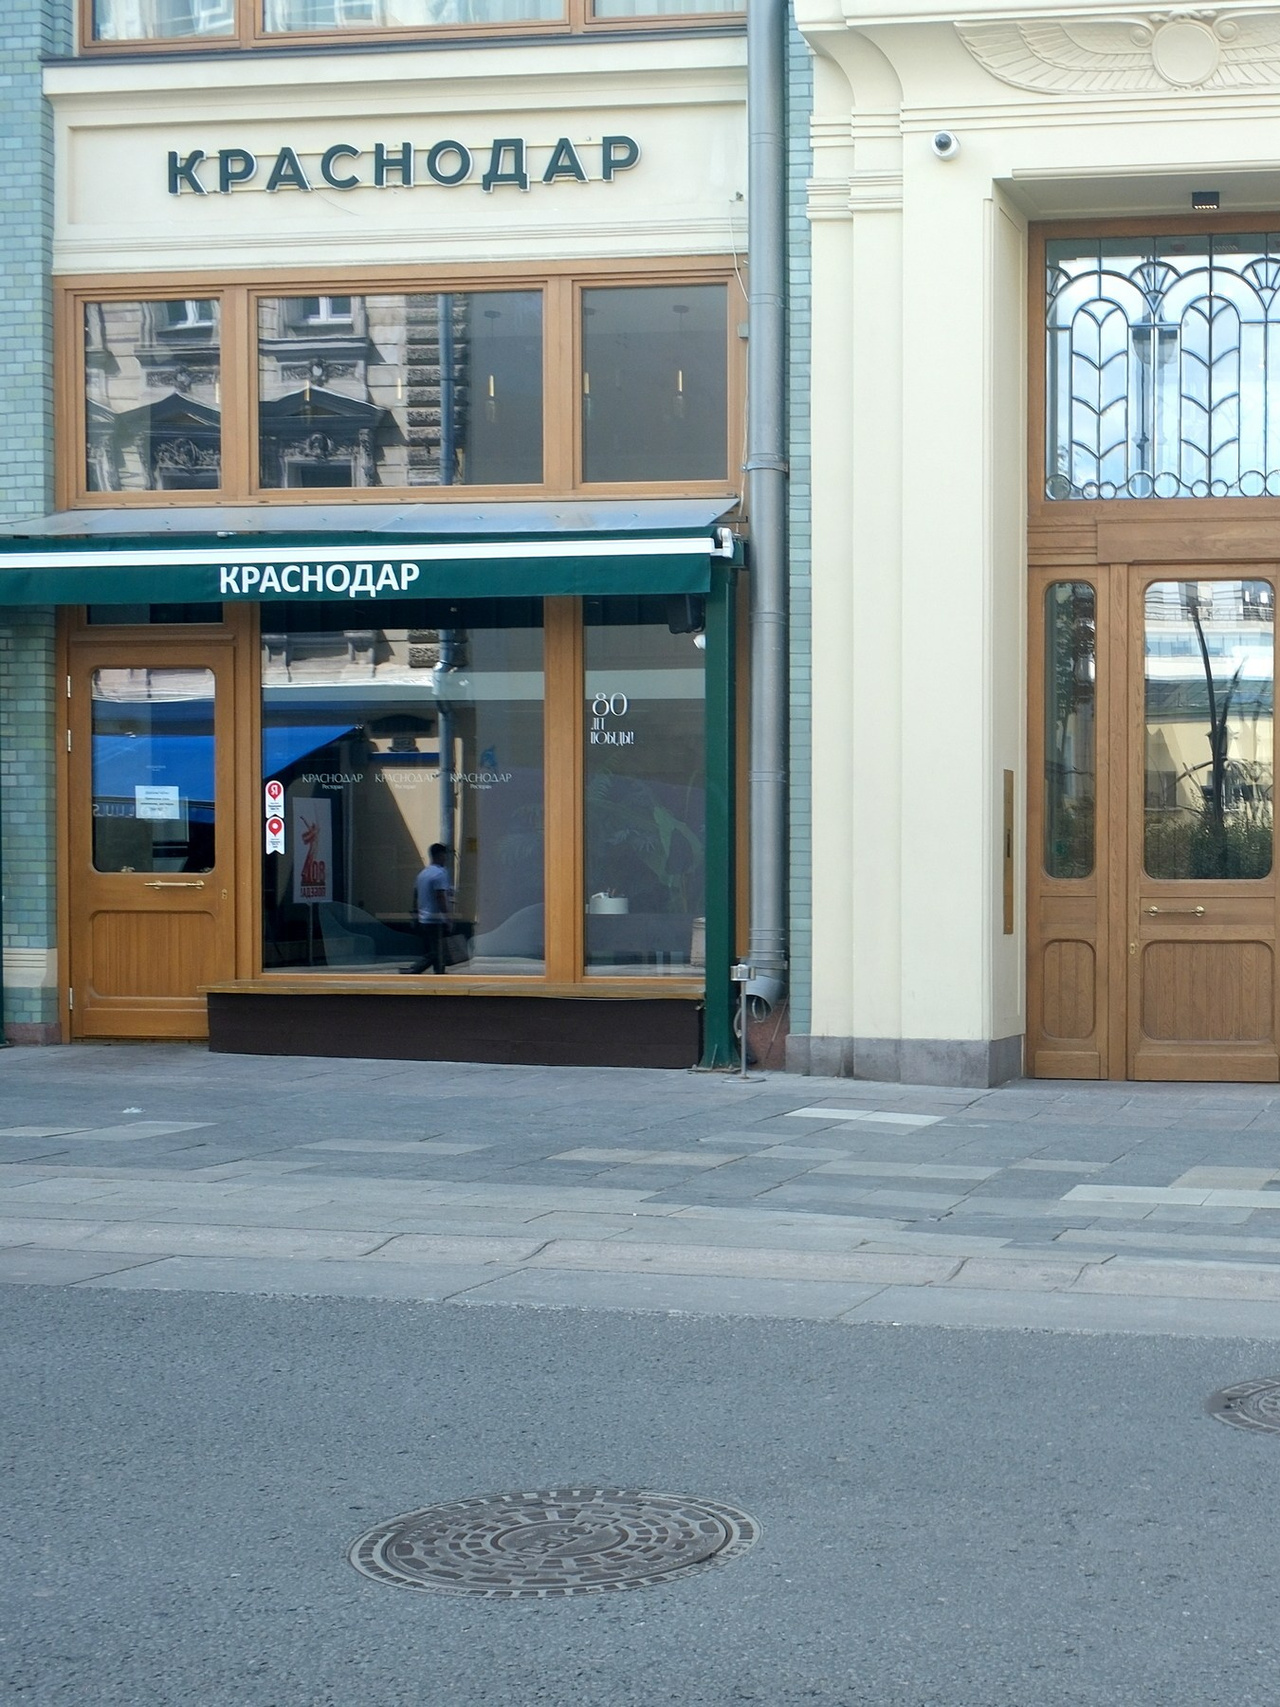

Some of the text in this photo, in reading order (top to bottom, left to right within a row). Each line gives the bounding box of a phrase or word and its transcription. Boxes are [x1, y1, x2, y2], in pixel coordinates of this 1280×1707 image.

[168, 135, 642, 196] КРАСНОДАР
[219, 563, 420, 598] КРАСНОДАР
[592, 692, 627, 716] 80
[302, 773, 363, 783] КРАСНОДАР
[450, 772, 512, 783] КРАСНОДАР
